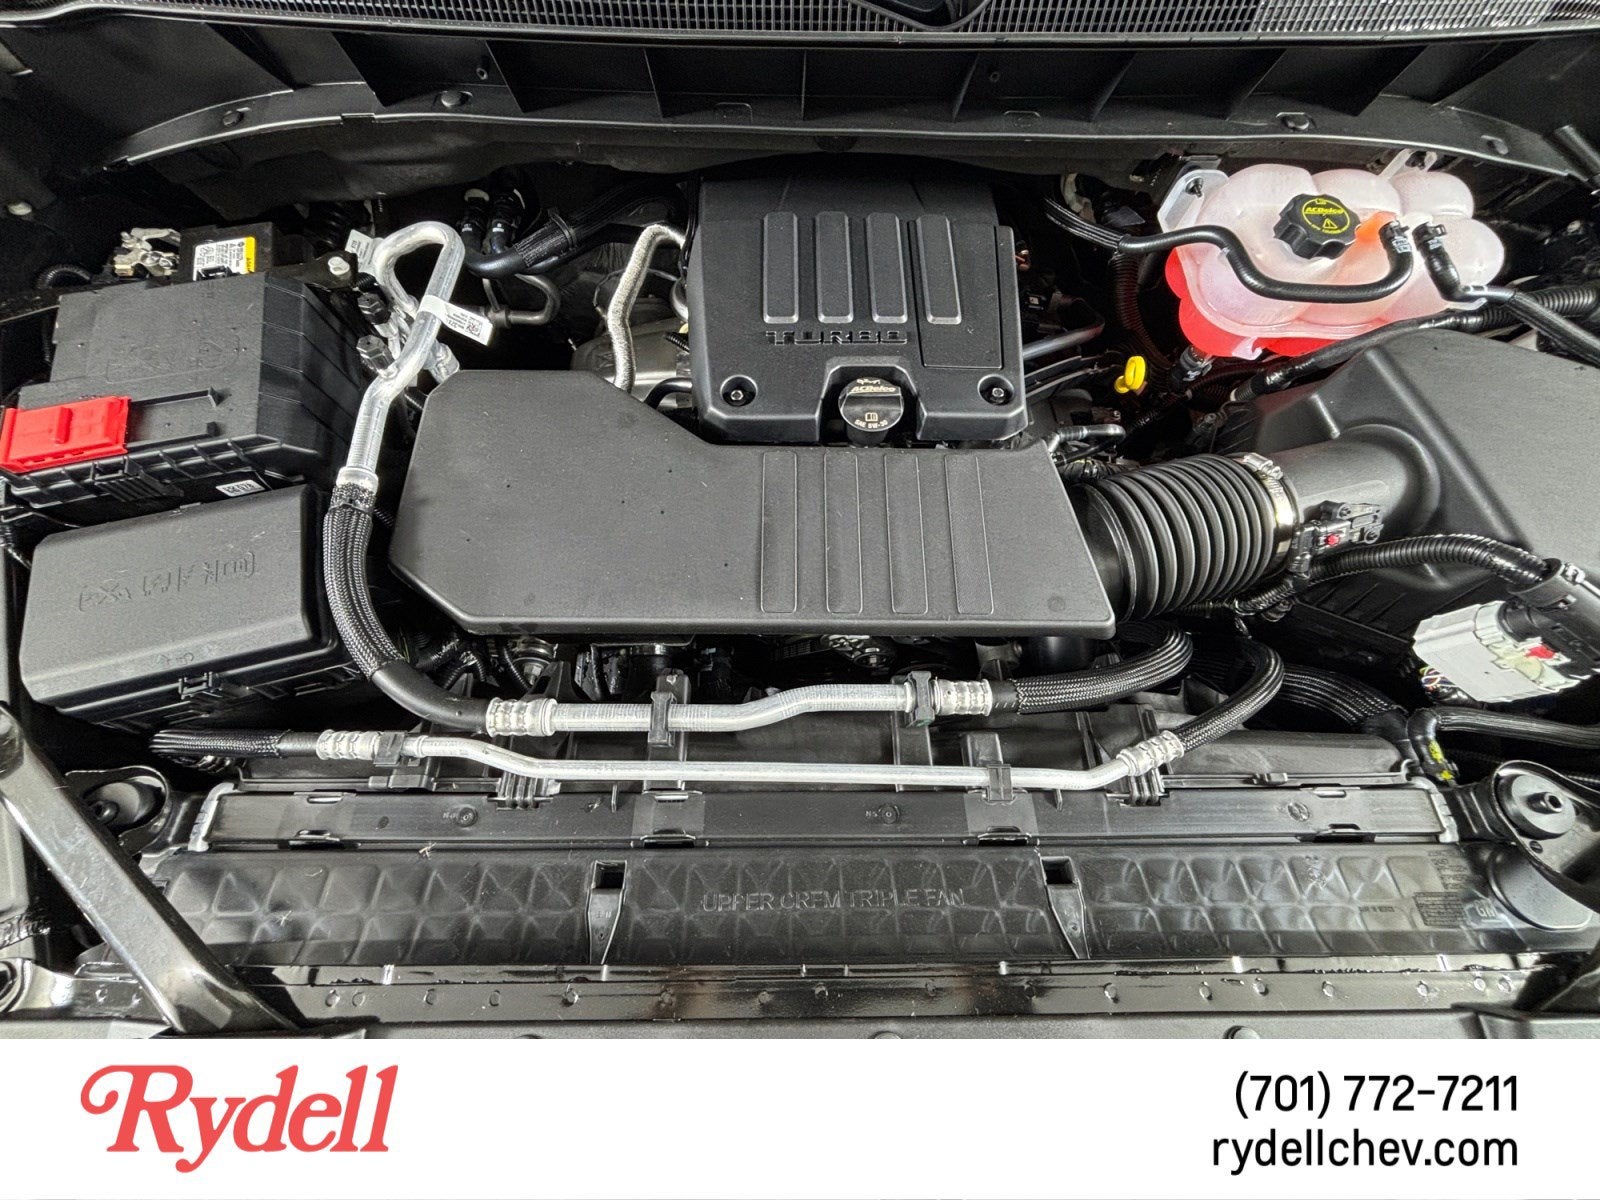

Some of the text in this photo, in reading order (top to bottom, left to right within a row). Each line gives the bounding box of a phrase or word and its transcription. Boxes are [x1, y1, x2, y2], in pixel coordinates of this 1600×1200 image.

[765, 330, 911, 346] TURBO
[850, 385, 897, 393] ACDelco
[702, 892, 775, 912] UPPER
[923, 887, 966, 907] FAN
